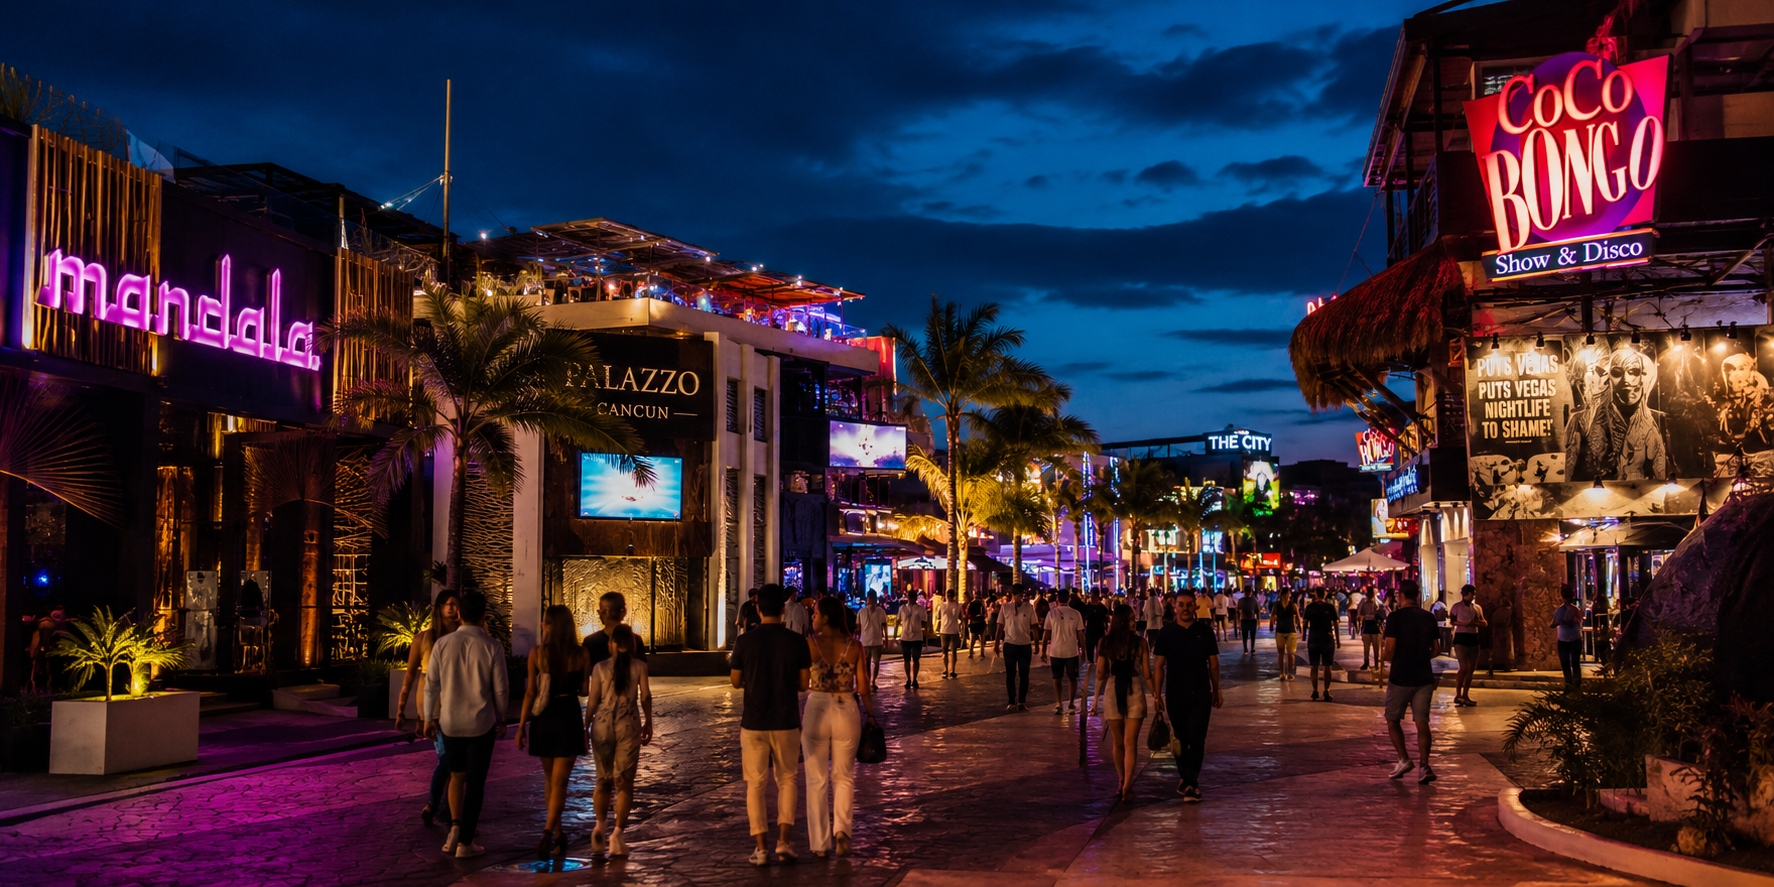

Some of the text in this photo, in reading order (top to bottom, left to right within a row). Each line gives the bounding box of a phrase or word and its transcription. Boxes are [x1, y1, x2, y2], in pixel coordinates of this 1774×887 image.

[1482, 115, 1664, 255] BONGO
[1495, 240, 1643, 275] Show & Disco
[35, 248, 321, 371] mandala
[1477, 355, 1512, 377] PUTS
[564, 361, 700, 396] PALAZZO
[1478, 379, 1557, 399] PUTS VEGAS
[597, 402, 669, 419] CANCUN
[1484, 399, 1551, 419] NIGHTLIFE
[1481, 421, 1498, 439] TO
[1208, 435, 1271, 451] THE CITY
